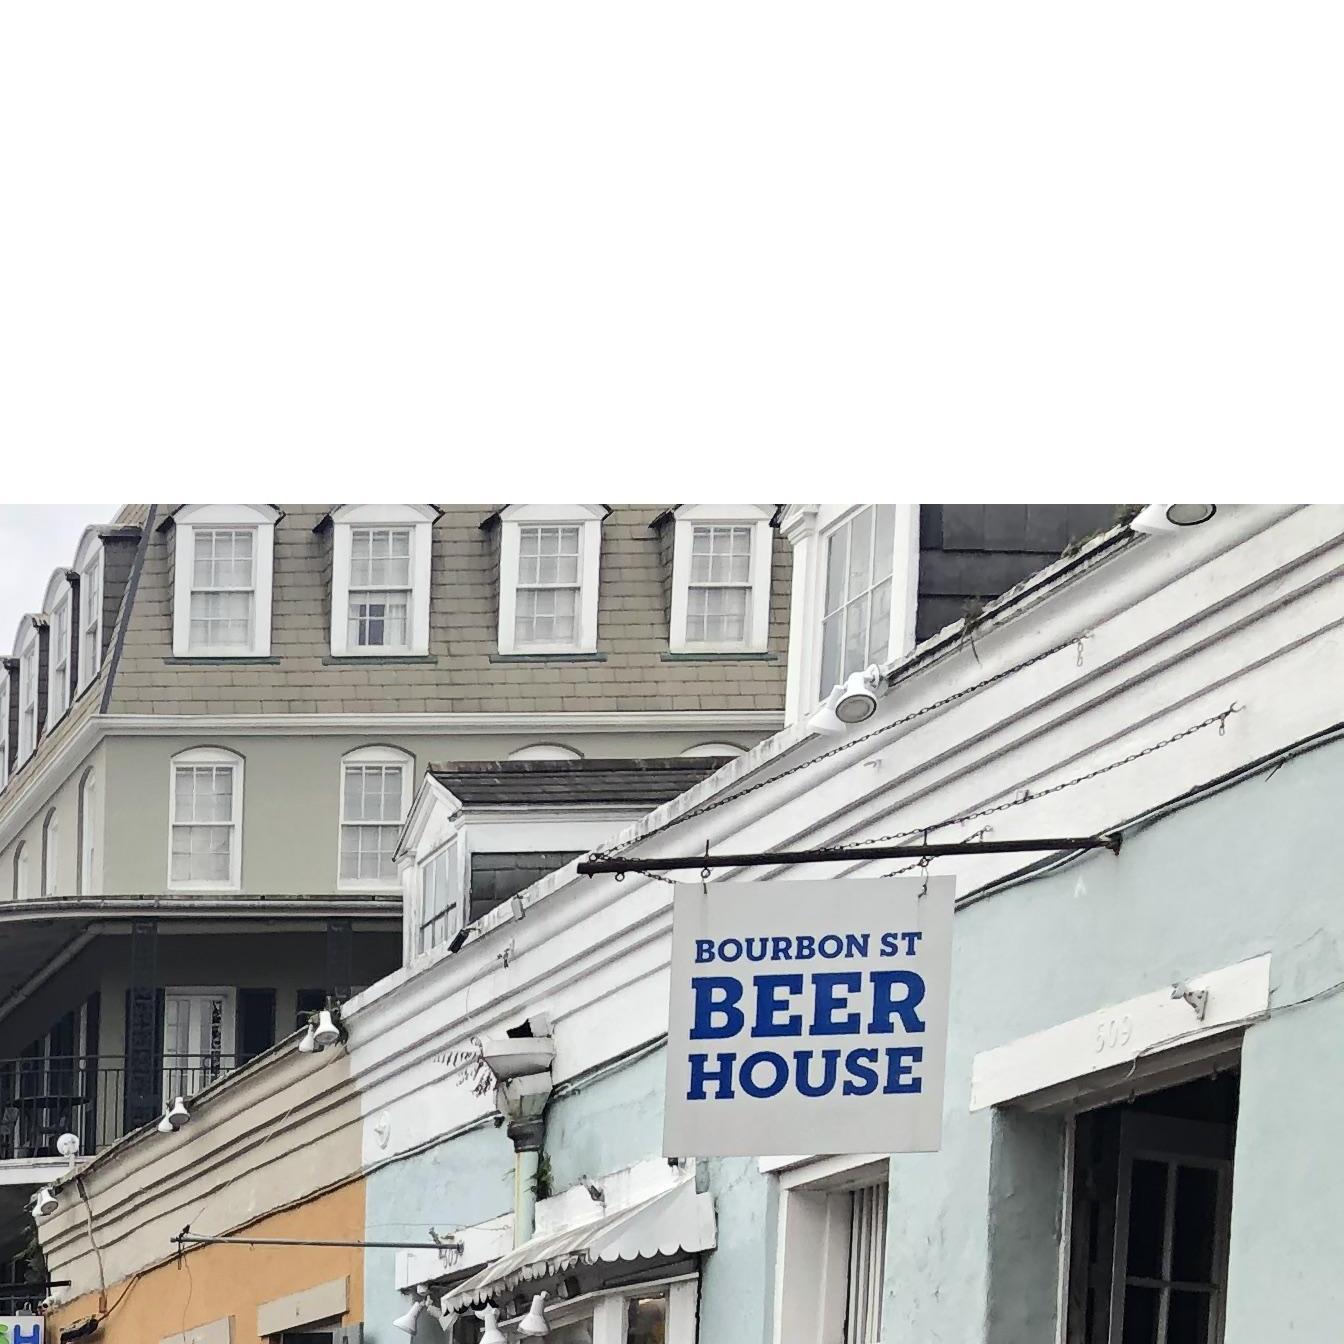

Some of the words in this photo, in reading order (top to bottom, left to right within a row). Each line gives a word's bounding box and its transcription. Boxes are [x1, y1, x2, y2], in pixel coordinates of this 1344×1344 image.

[694, 932, 871, 964] BOURBON
[879, 931, 924, 959] ST
[689, 969, 926, 1041] BEER
[686, 1046, 924, 1101] HOUSE
